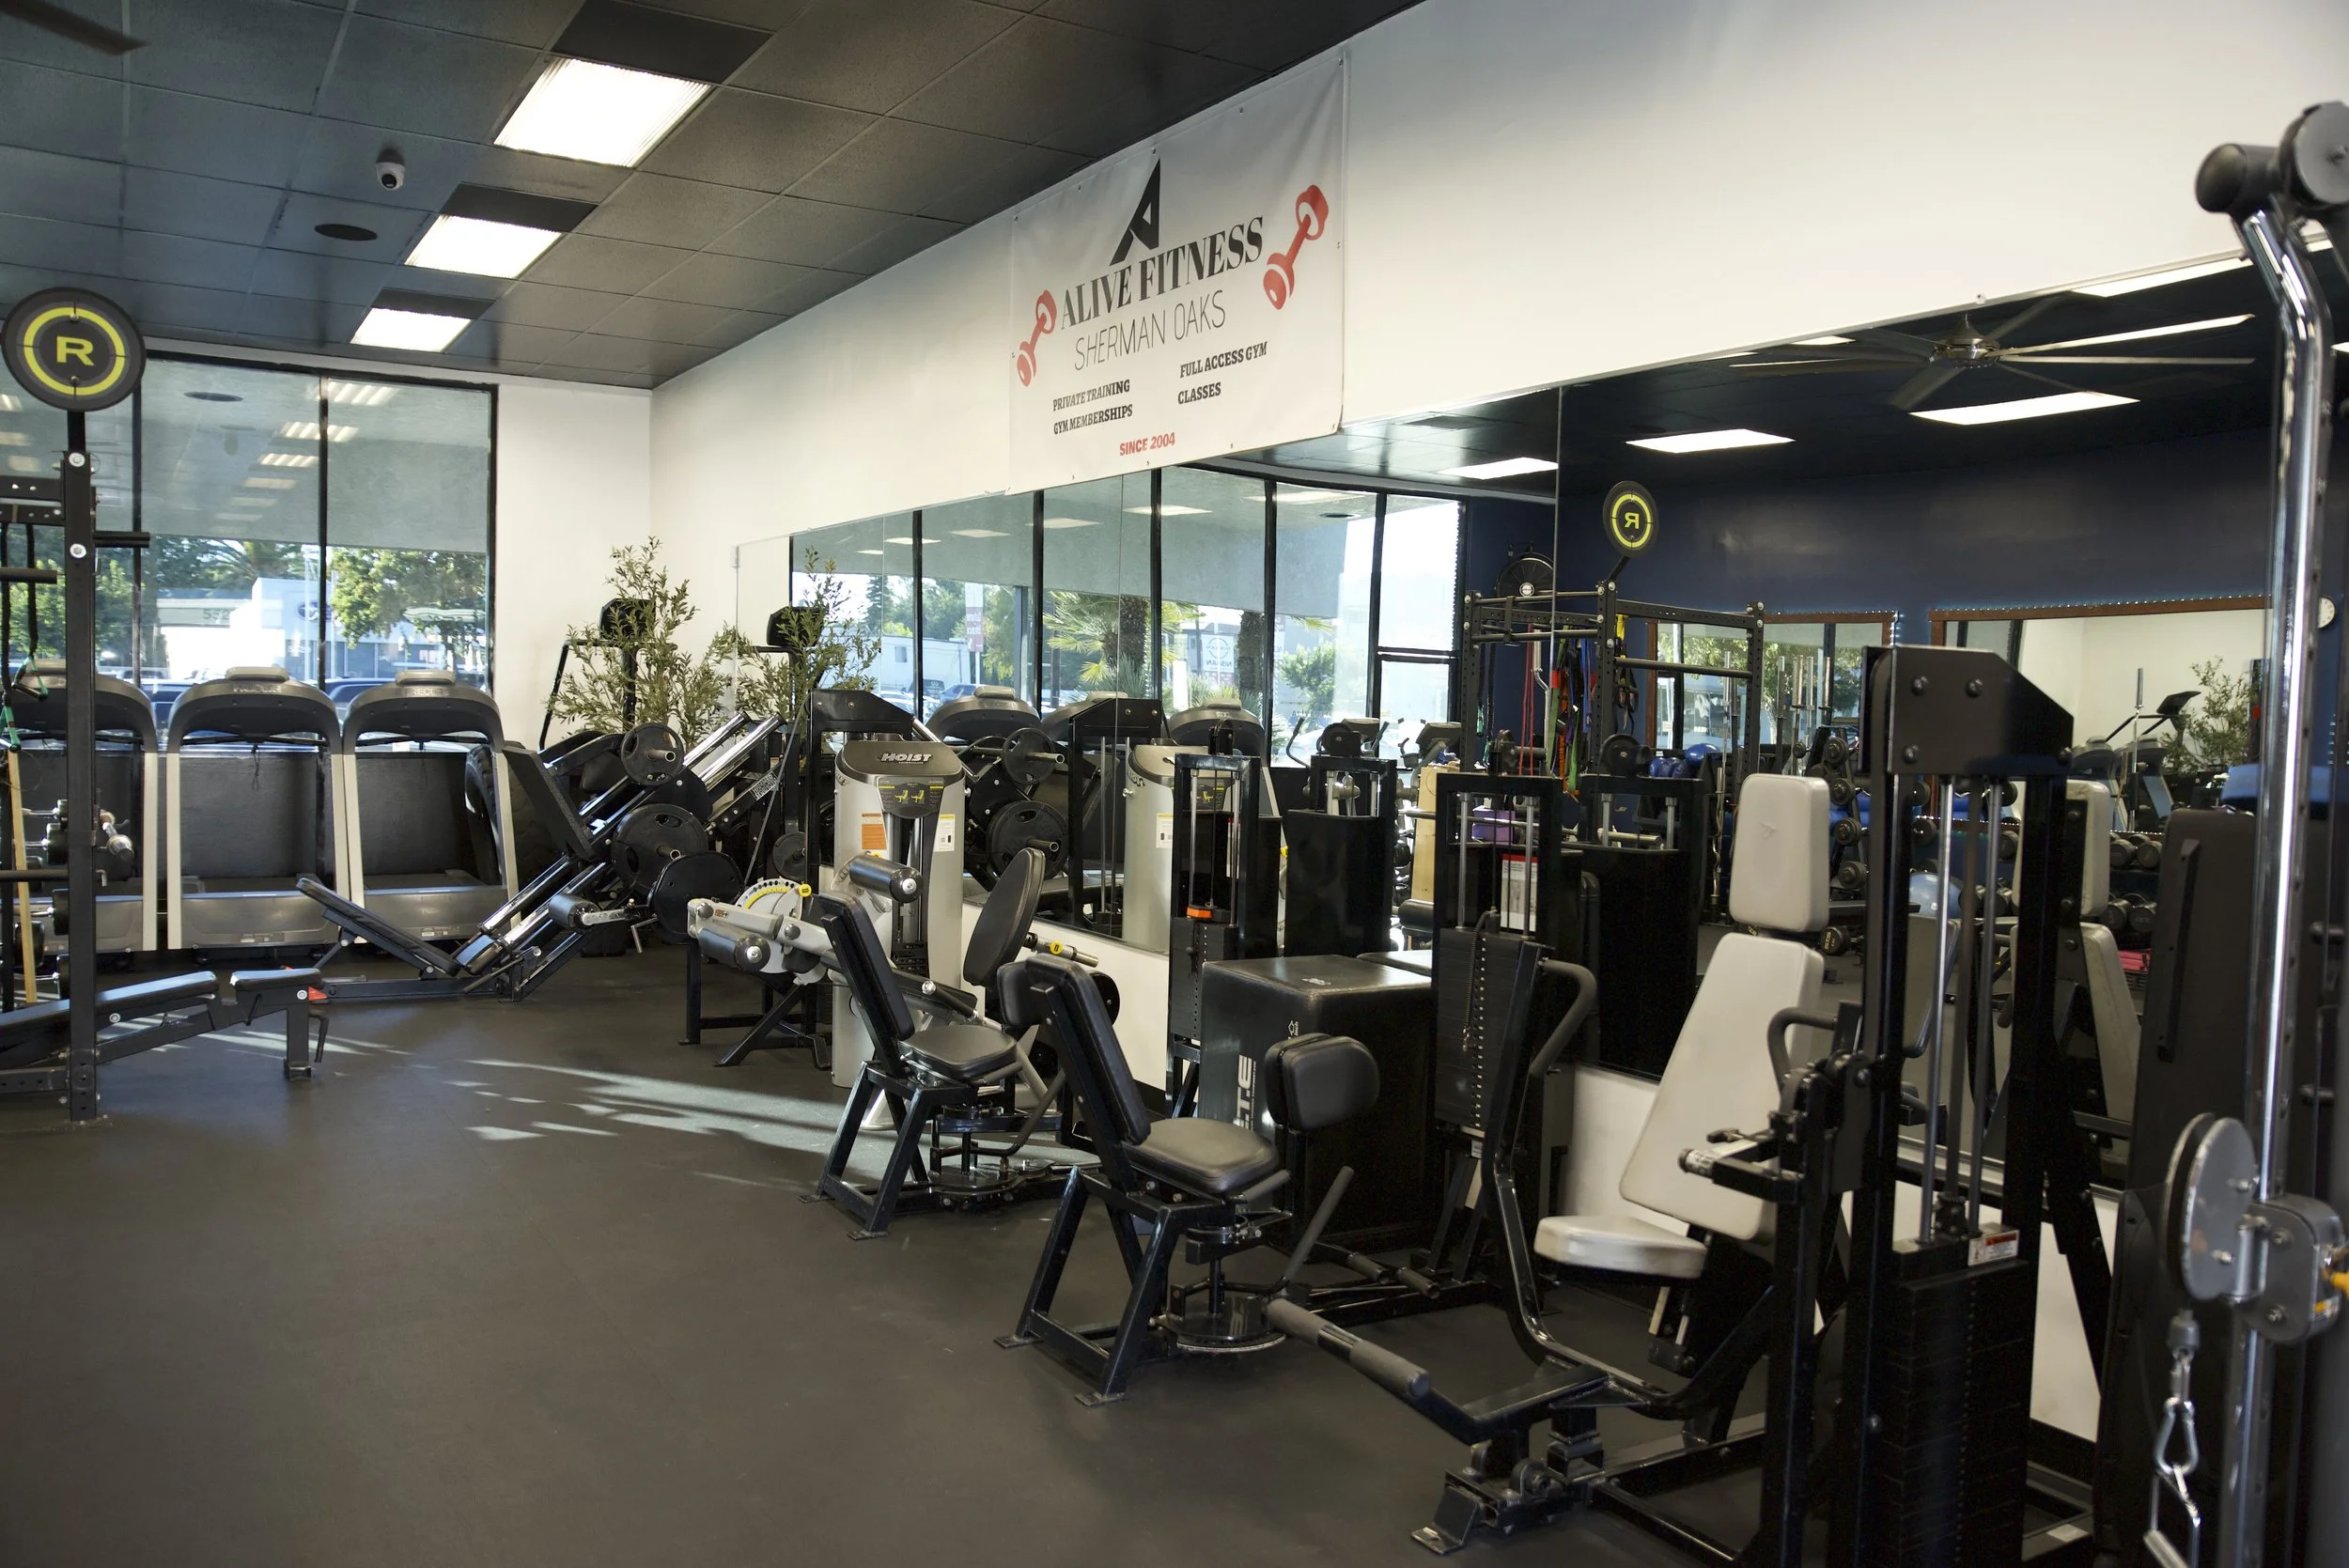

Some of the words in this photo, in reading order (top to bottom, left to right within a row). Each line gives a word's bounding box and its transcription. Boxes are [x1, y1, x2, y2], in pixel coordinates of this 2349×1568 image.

[1061, 265, 1131, 330] ALIVE
[1138, 215, 1263, 302] FITNESS
[1074, 309, 1166, 371] SHERMAN
[1174, 289, 1225, 340] OAKS
[56, 335, 95, 366] R
[1179, 359, 1204, 378] FULL
[1204, 348, 1244, 371] ACCESS
[1245, 341, 1268, 361] GYM
[1052, 391, 1086, 411] PRIVATE
[1086, 379, 1130, 402] TRAINING
[1177, 381, 1221, 405] CLASSES
[1053, 419, 1068, 435] GYM
[1069, 403, 1133, 430] MEMBERSHIPS
[1119, 438, 1147, 456] SINCE
[1150, 432, 1175, 449] 2004
[880, 753, 932, 762] HOIST
